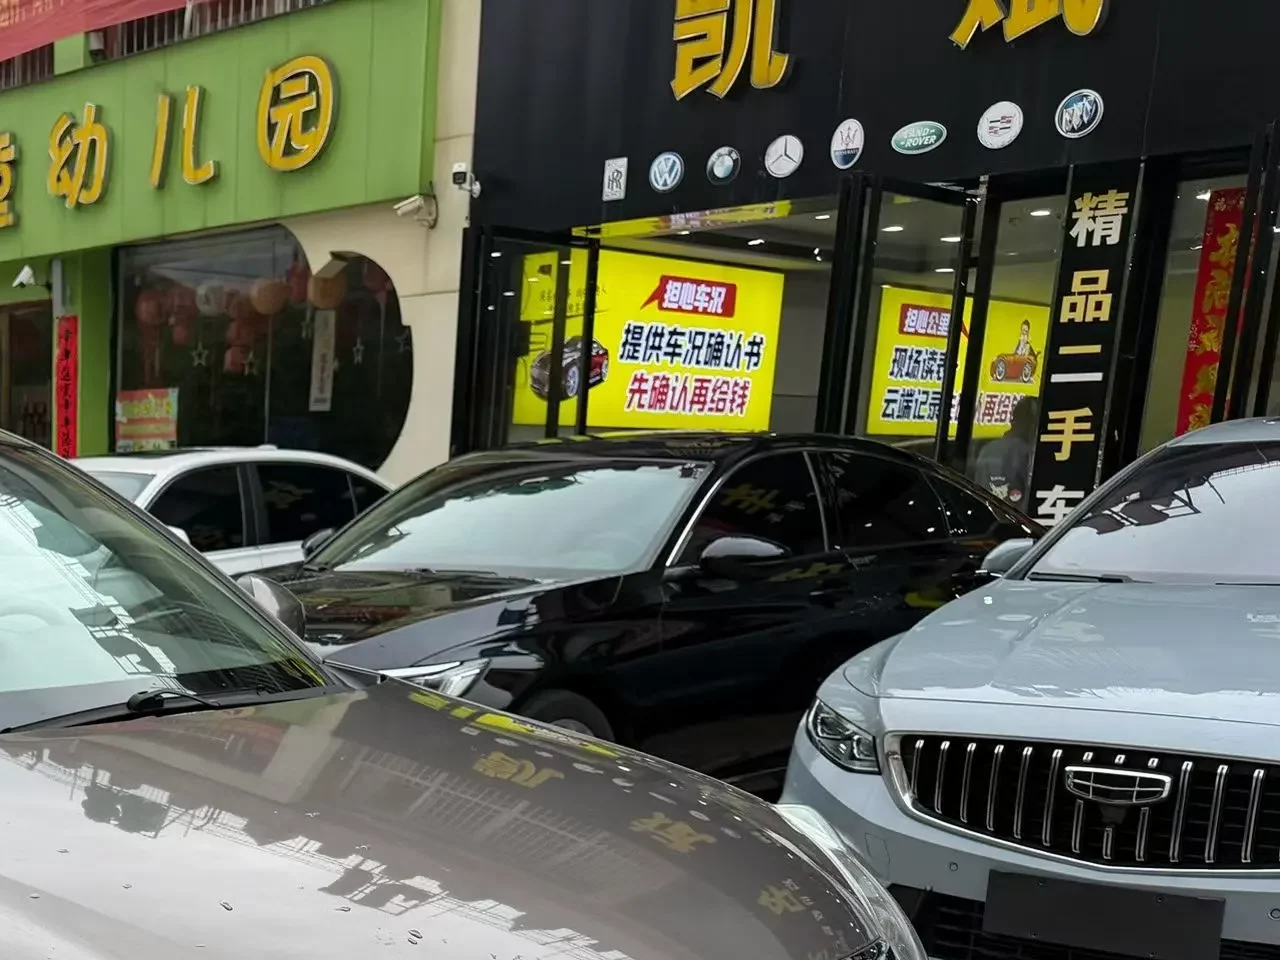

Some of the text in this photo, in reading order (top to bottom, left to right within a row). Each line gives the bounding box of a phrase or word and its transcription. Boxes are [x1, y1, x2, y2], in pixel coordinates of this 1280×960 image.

[905, 135, 937, 148] ROVER
[663, 280, 726, 313] 担心车况
[619, 323, 766, 371] 提供车况确认书
[1035, 189, 1130, 526] 精品二手车
[625, 371, 751, 415] 先确认再给钱
